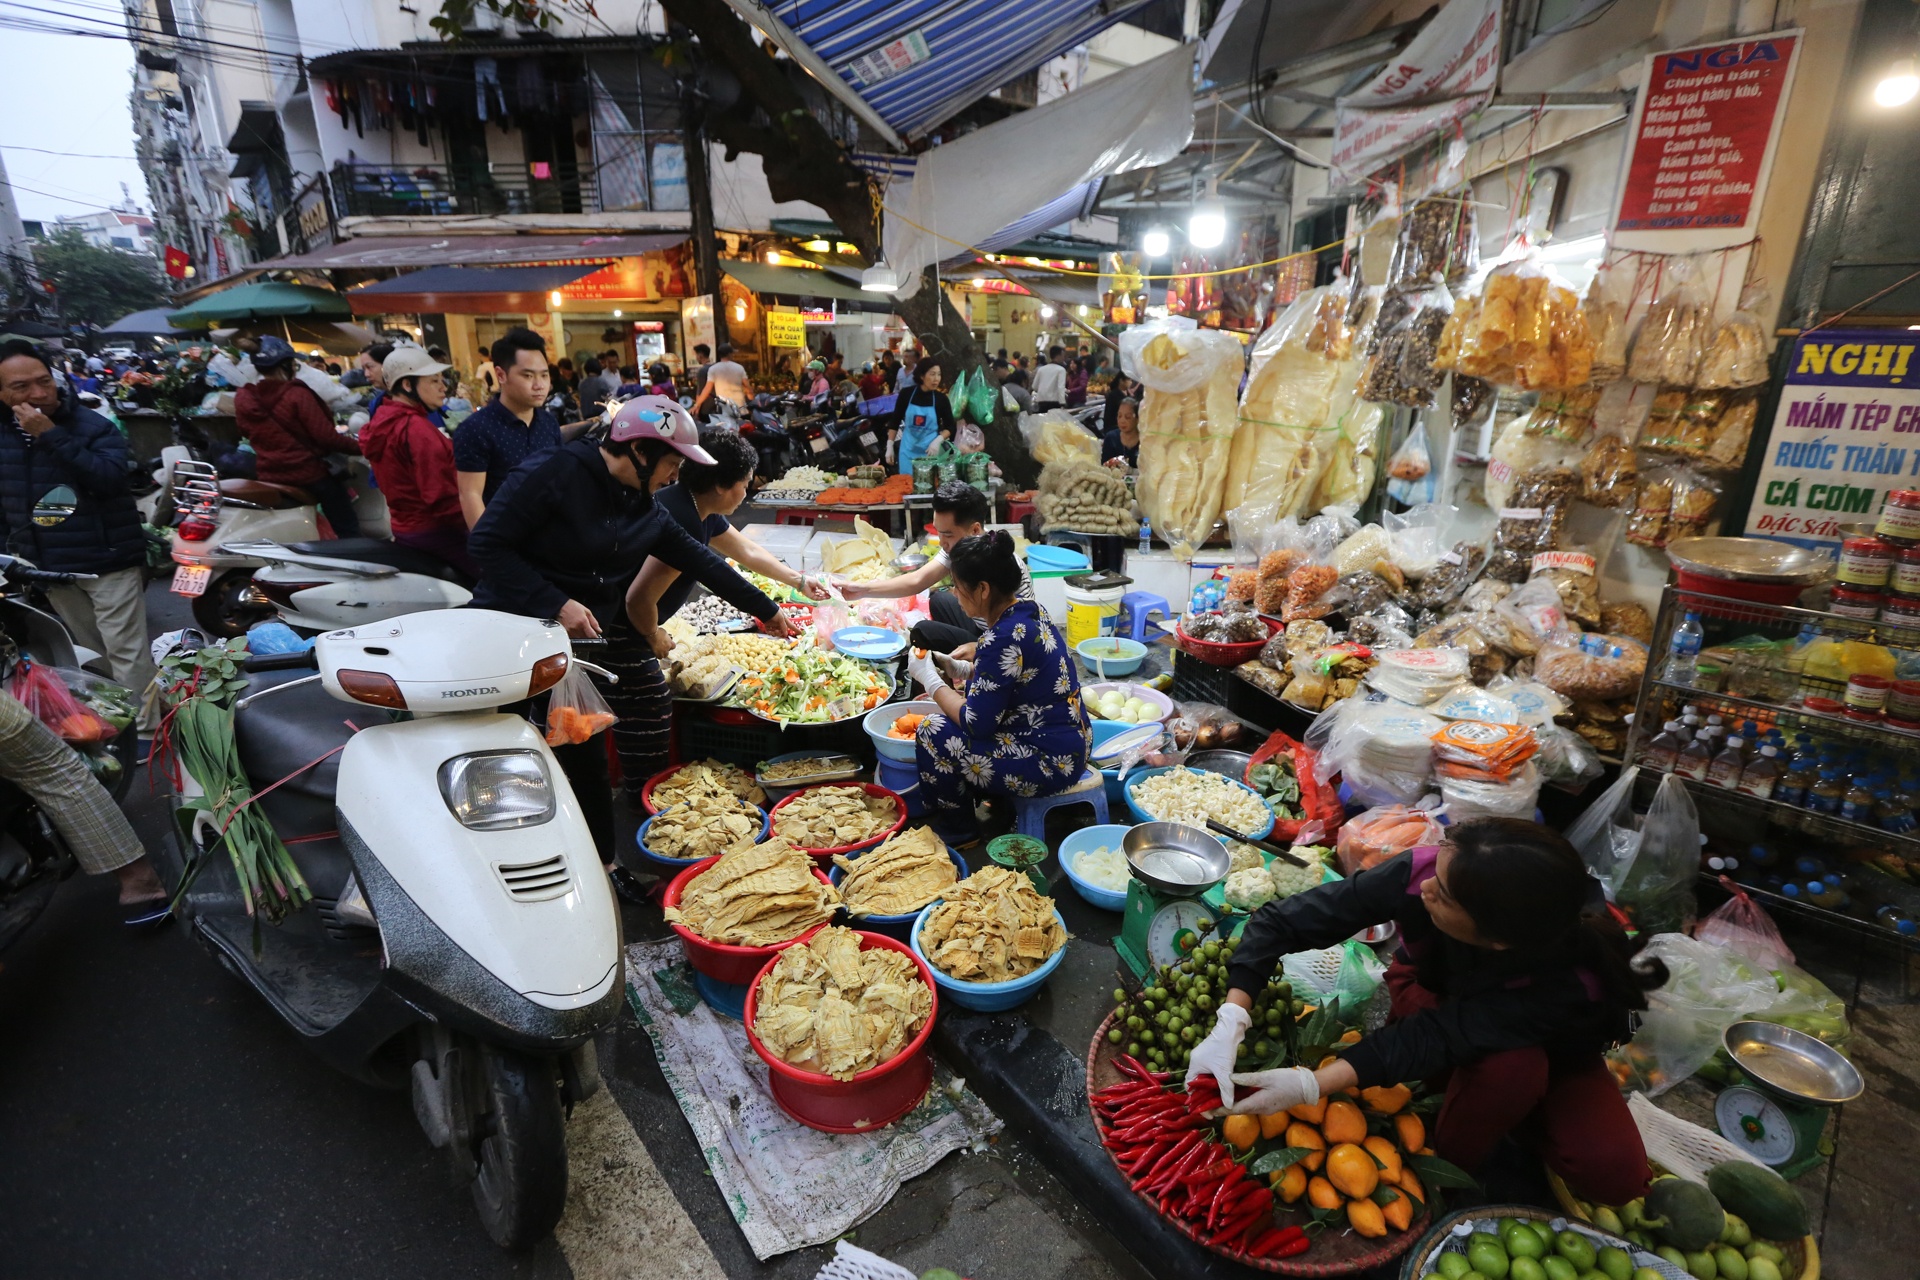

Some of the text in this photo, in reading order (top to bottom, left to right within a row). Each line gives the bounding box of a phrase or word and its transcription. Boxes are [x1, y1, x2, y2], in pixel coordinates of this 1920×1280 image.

[1664, 42, 1780, 75] NGA
[1372, 63, 1424, 96] NGA
[1796, 343, 1916, 384] NGHỊ
[1785, 392, 1849, 430] MẮM
[1849, 398, 1892, 432] TÉP
[1774, 435, 1839, 470] RUỐC
[1842, 442, 1908, 476] THĂN
[1764, 477, 1805, 506] CÁ
[1805, 482, 1876, 514] CƠM
[441, 686, 501, 699] HONDA
